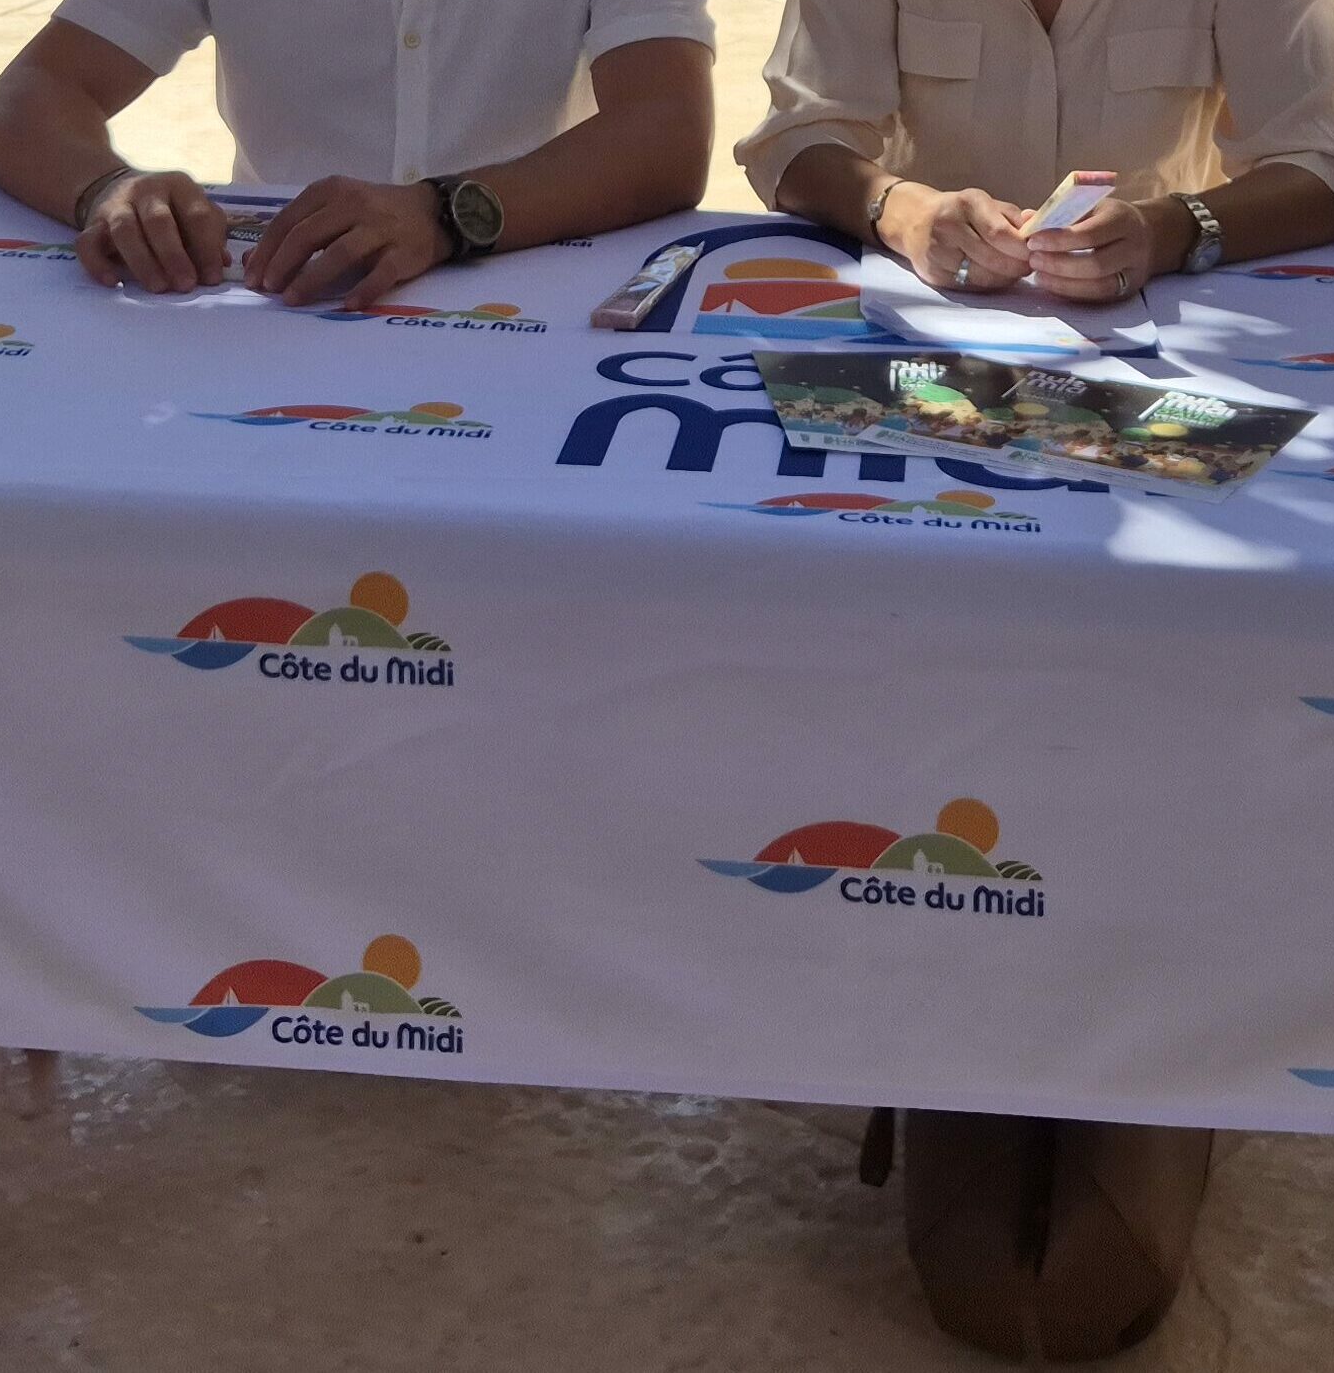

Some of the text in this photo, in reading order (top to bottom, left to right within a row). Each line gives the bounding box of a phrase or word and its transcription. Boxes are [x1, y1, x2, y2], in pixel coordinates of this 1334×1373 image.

[386, 317, 446, 328] Côte
[452, 319, 485, 330] du
[309, 420, 376, 435] Côte
[384, 422, 423, 437] du
[838, 511, 914, 528] Côte
[921, 515, 965, 530] du
[259, 652, 455, 687] Côte du Midi
[840, 875, 1045, 917] Côte du Midi
[271, 1013, 464, 1053] Côte du Midi
